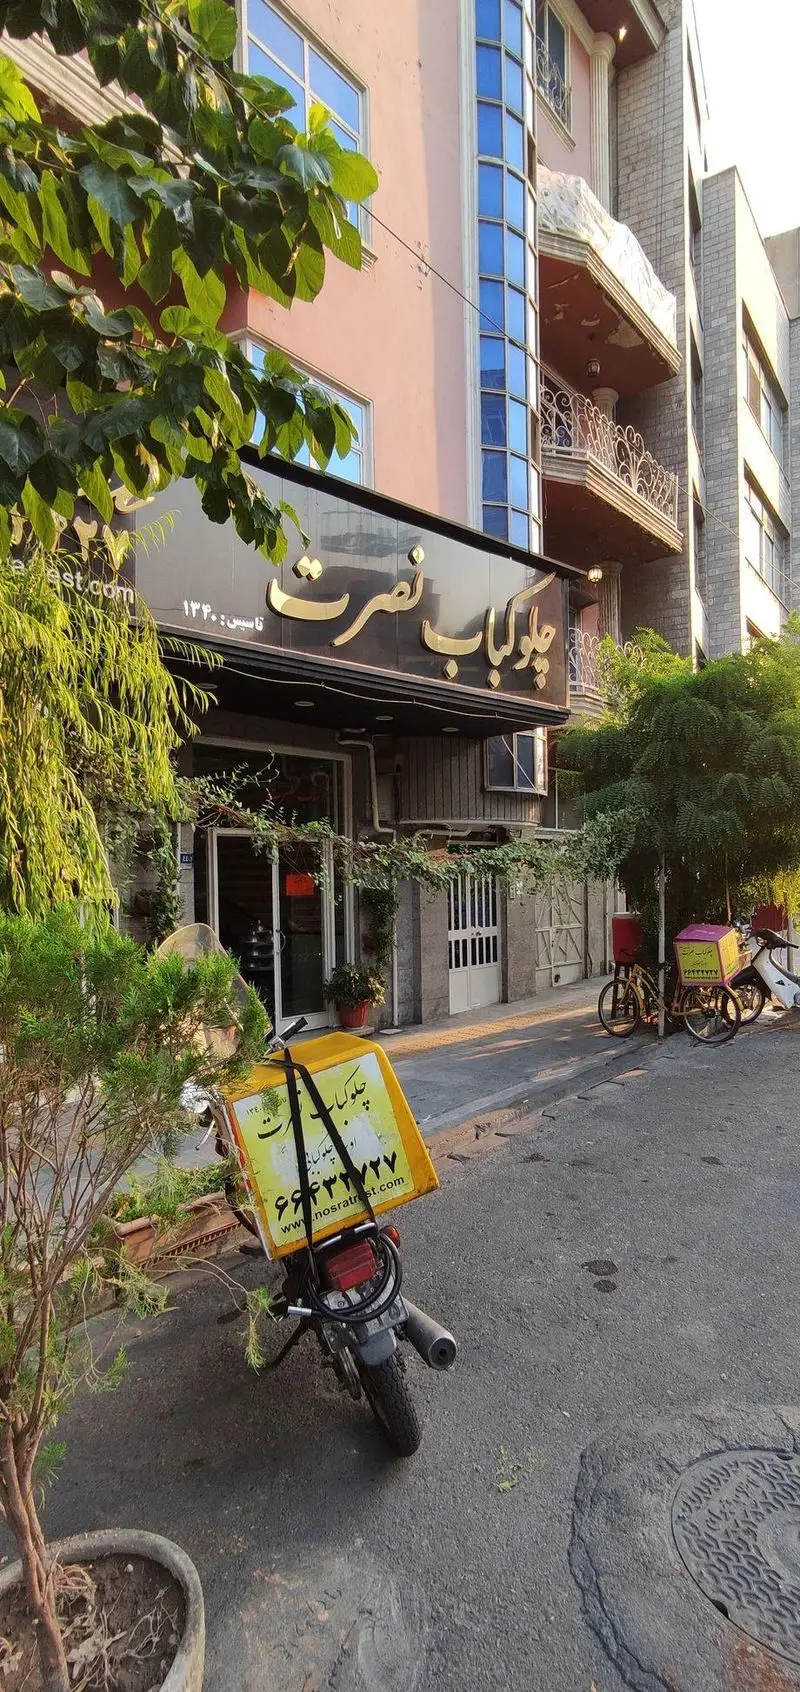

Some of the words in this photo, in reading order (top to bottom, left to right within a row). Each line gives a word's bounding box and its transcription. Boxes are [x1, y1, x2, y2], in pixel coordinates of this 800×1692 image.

[183, 599, 218, 622] ۱۳۴۰
[266, 544, 426, 647] نصرت
[420, 571, 557, 690] چلوکباب
[280, 1175, 406, 1235] www.nosratrst.com
